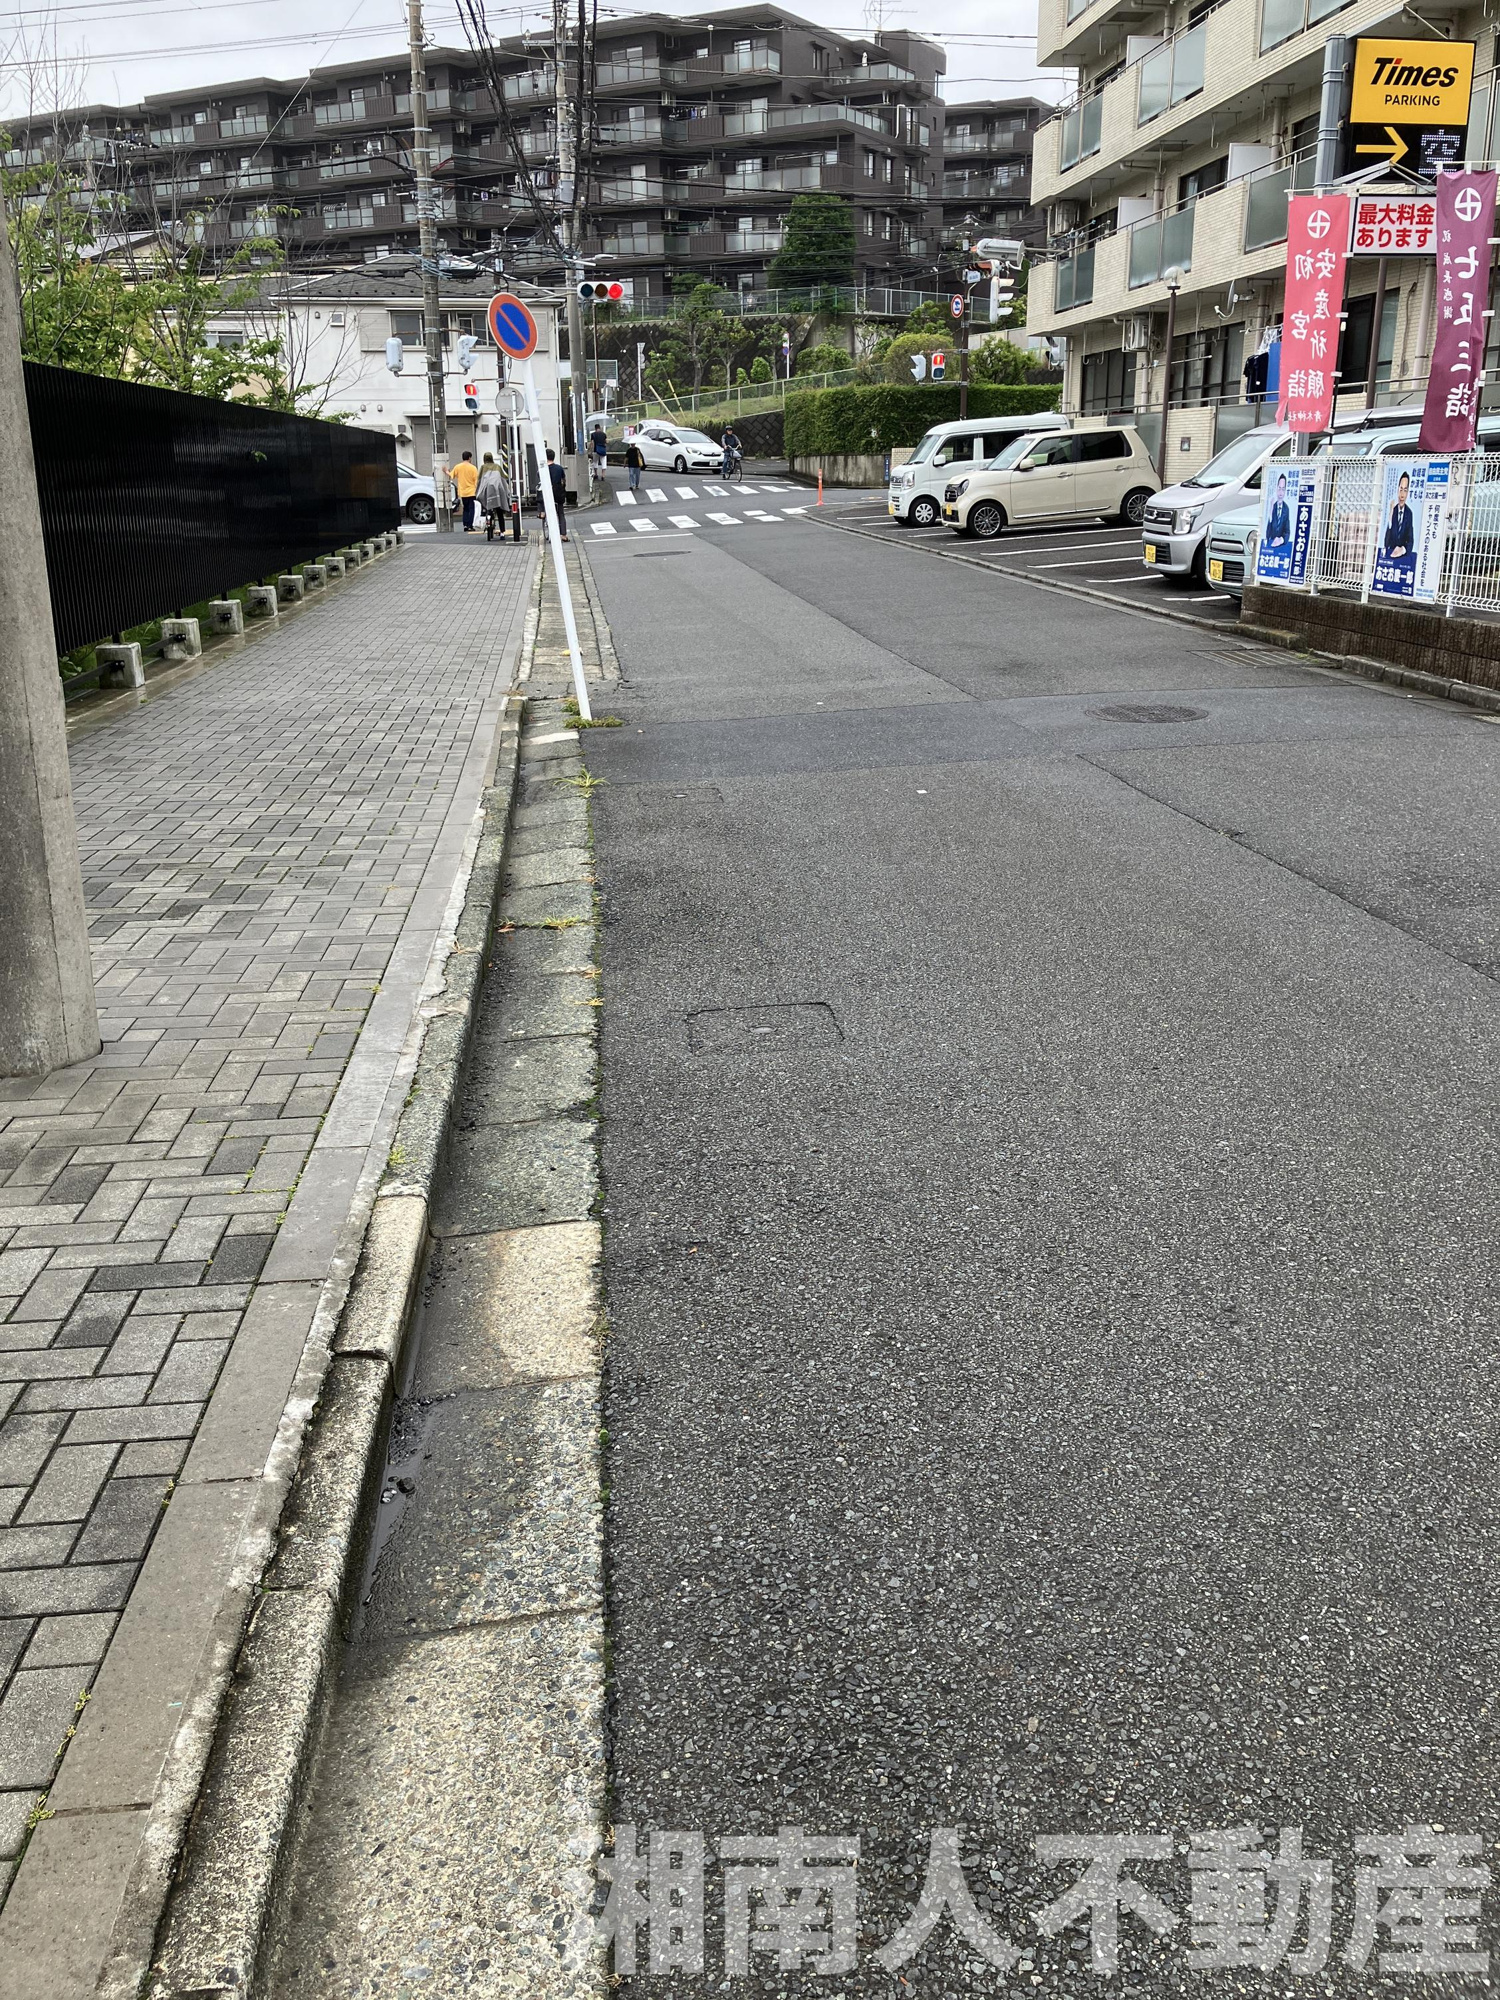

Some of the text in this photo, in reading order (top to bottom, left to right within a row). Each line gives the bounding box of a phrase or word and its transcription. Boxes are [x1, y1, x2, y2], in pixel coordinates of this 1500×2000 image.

[1370, 57, 1459, 87] Times
[1384, 94, 1441, 107] PARKING
[1418, 129, 1461, 174] 空
[1358, 203, 1435, 226] 最大料金
[1357, 227, 1433, 248] あります
